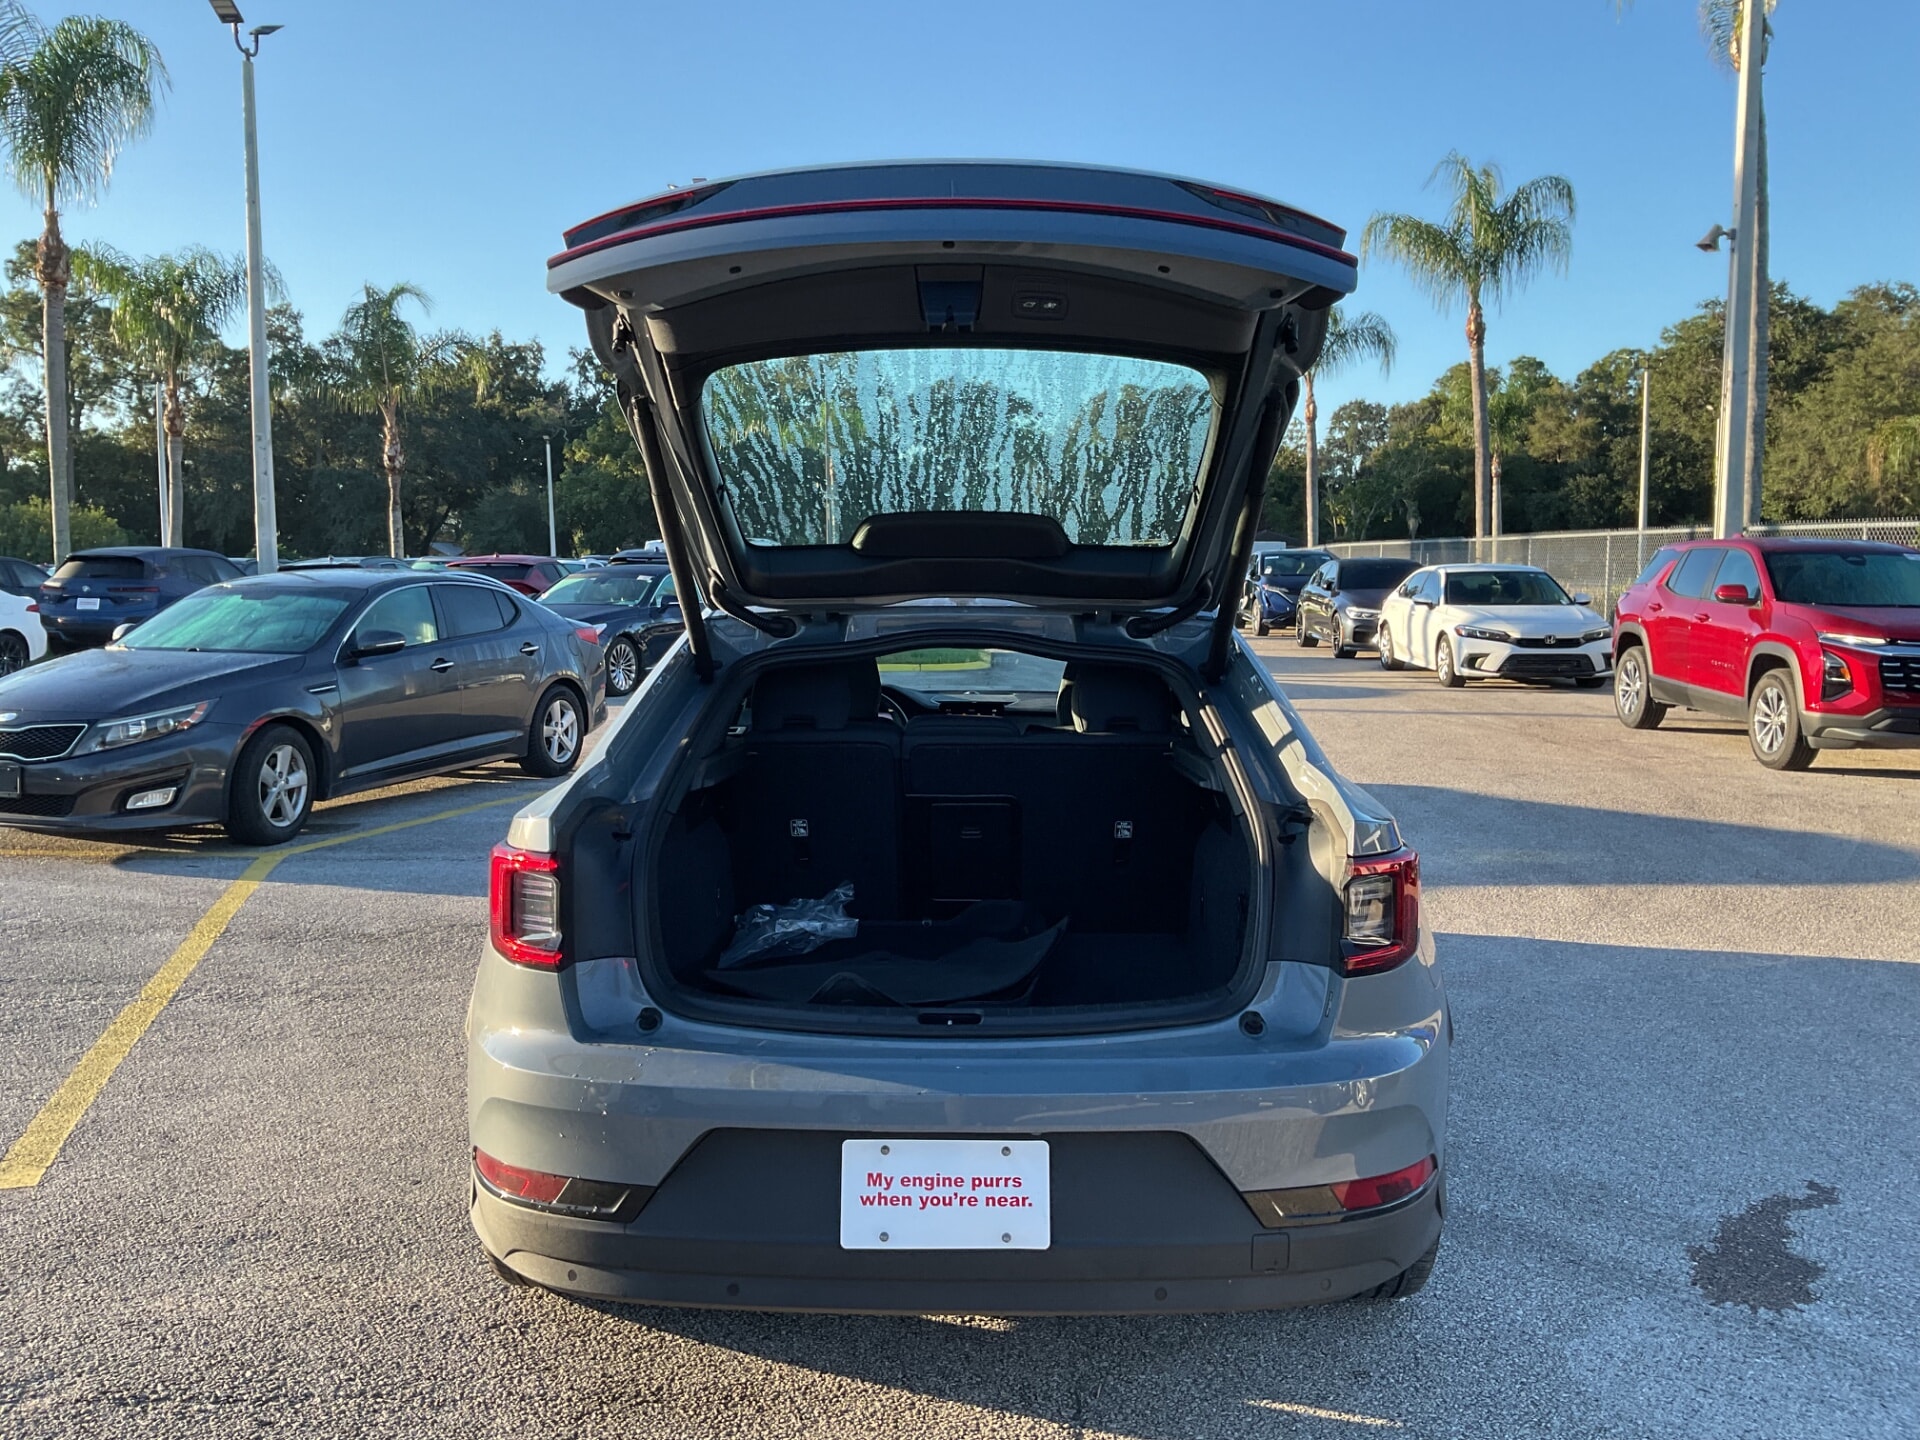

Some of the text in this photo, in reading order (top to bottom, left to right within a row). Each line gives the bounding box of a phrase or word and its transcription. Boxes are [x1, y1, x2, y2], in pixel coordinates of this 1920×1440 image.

[867, 1172, 1023, 1191] My engine purrs
[860, 1192, 1033, 1210] when you're near.
